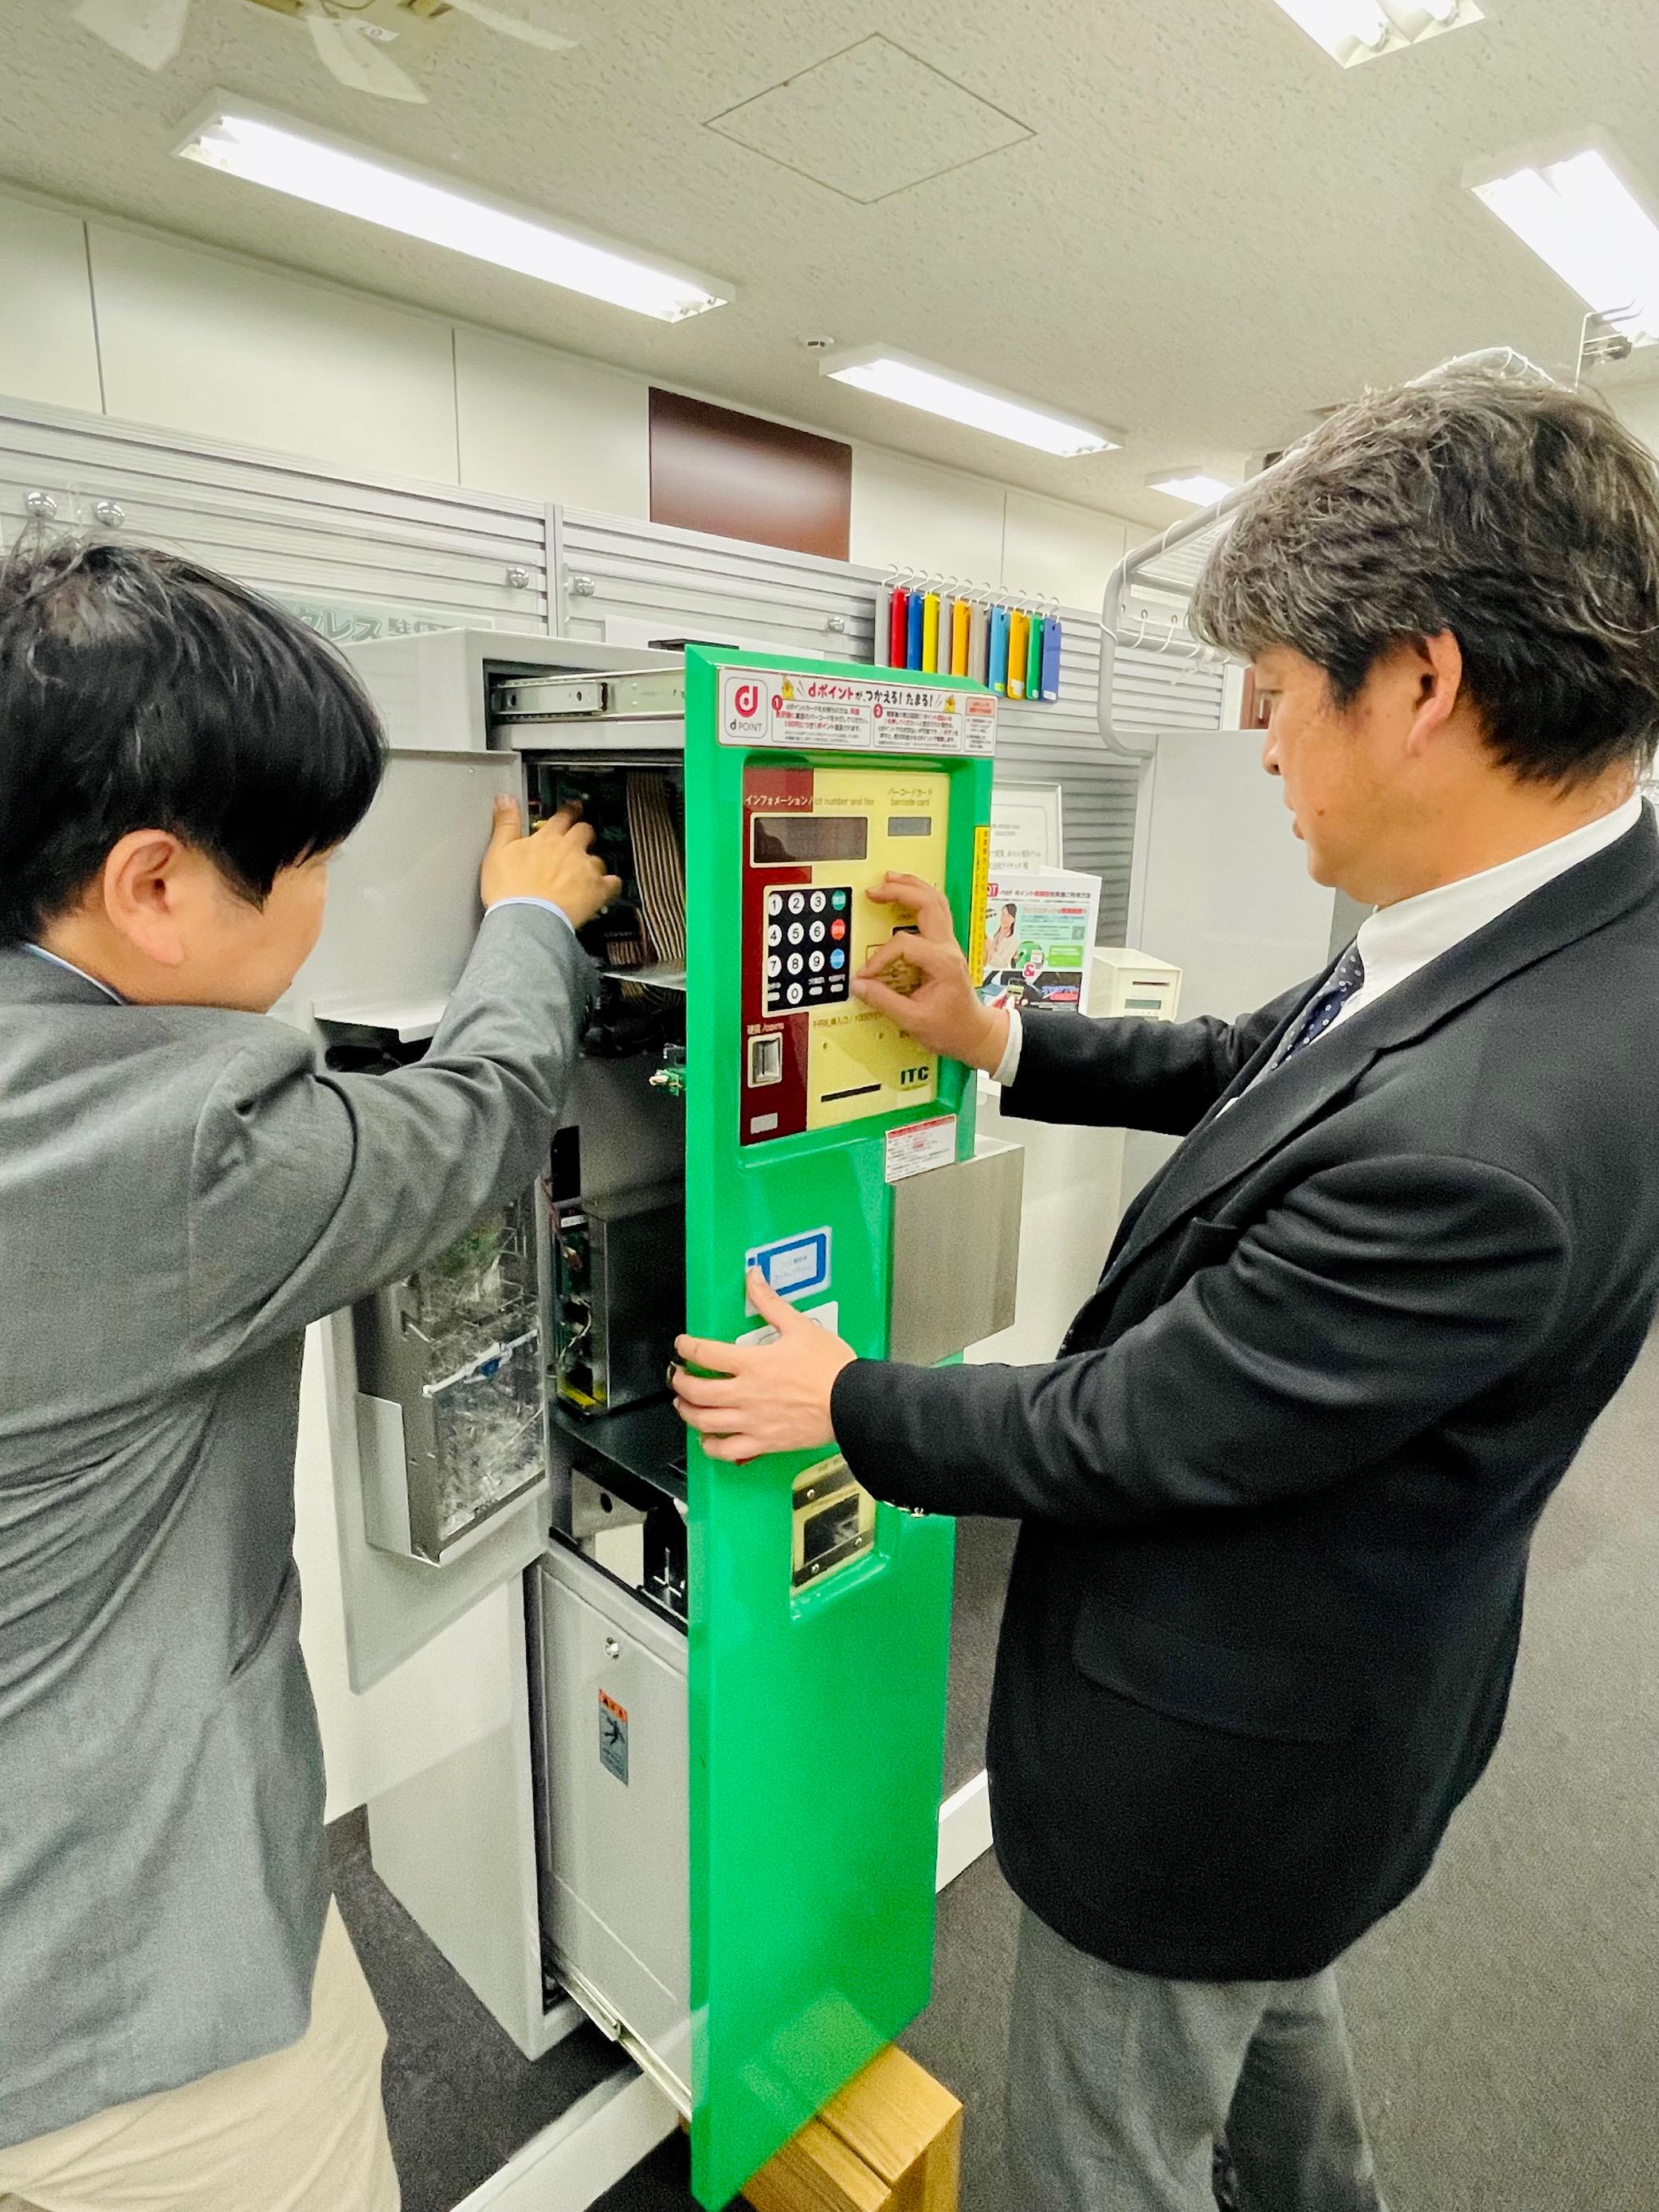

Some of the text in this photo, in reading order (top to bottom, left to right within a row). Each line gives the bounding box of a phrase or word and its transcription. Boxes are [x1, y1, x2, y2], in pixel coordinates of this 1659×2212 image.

[739, 722, 763, 732] POINT
[771, 900, 777, 910] 1
[793, 898, 800, 908] 2
[814, 896, 822, 908] 3
[770, 930, 777, 940] 4
[792, 928, 799, 939] 5
[814, 926, 821, 937] 6
[770, 960, 777, 971] 7
[792, 958, 799, 969] 8
[813, 956, 820, 967] 9
[791, 988, 798, 999] 0
[900, 1066, 929, 1084] ITC
